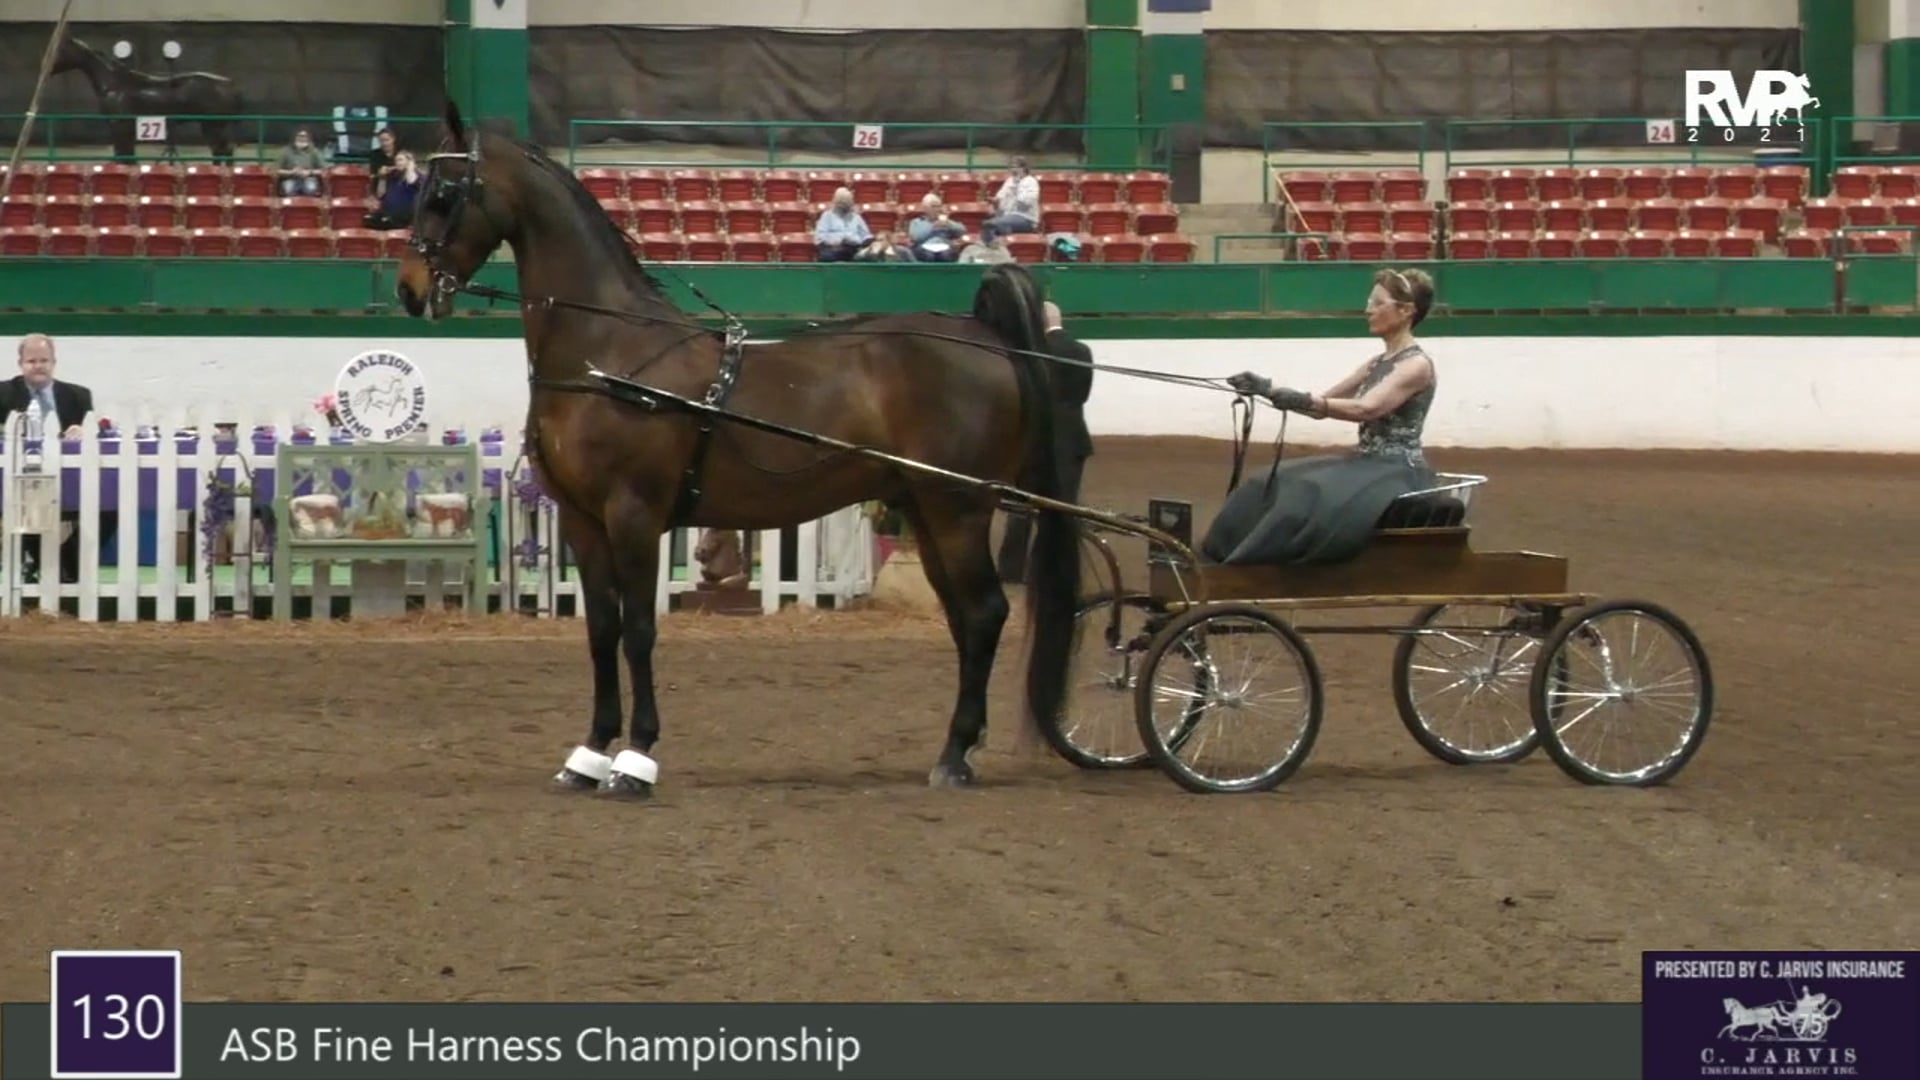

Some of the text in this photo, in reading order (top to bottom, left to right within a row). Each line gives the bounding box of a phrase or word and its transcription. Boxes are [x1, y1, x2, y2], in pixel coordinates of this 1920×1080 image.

[141, 122, 161, 138] 27
[1651, 125, 1671, 141] 24
[858, 131, 878, 146] 26
[347, 354, 413, 377] RALEIGH
[338, 386, 424, 439] SPRING PREMIER
